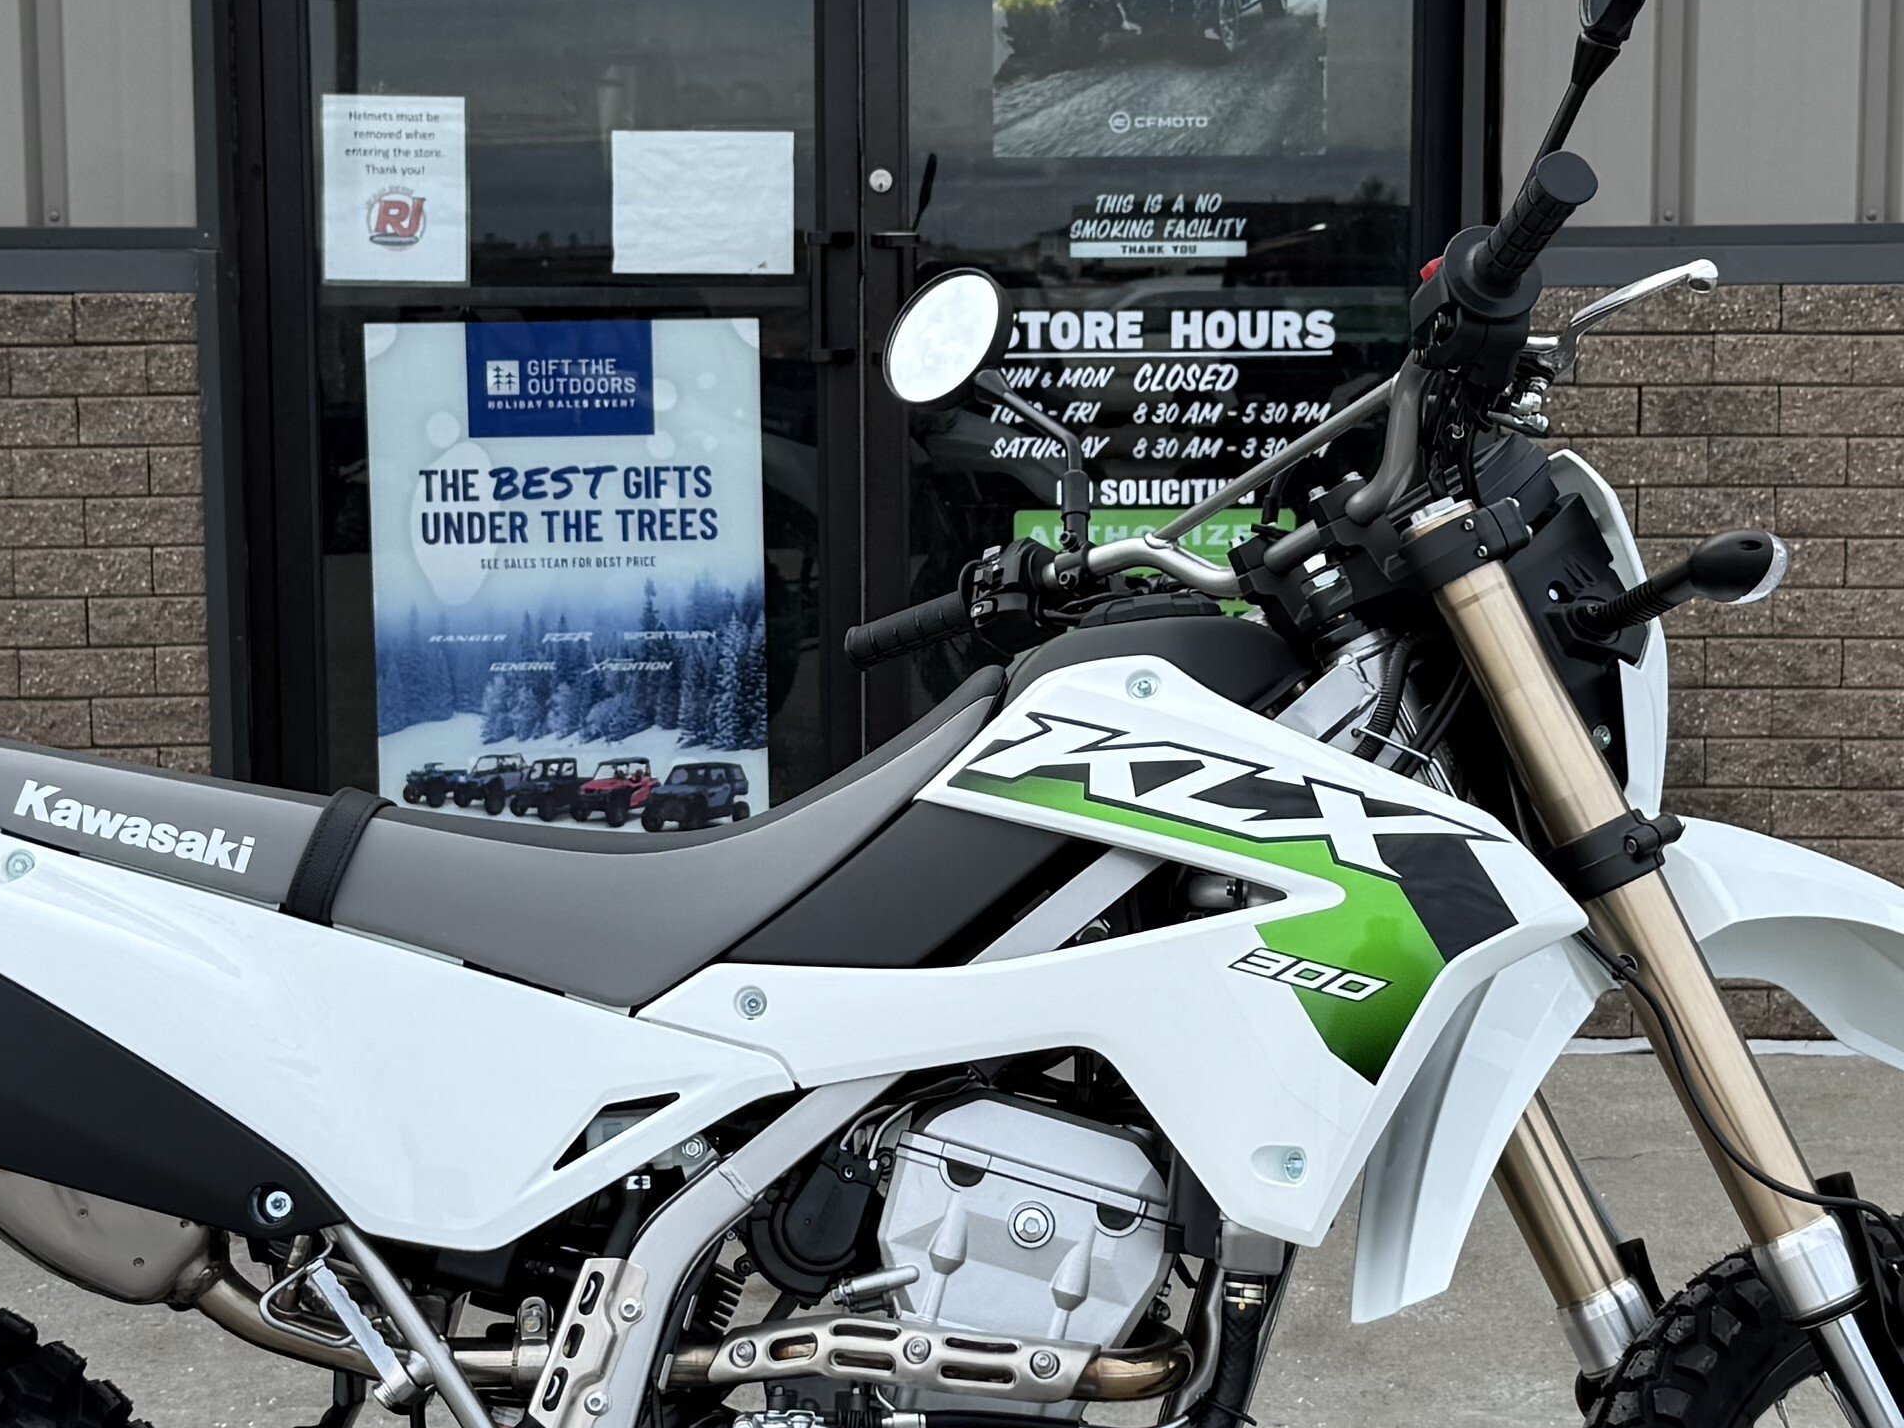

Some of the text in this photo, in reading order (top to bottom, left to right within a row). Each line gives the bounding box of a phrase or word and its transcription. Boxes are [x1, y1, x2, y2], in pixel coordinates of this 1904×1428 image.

[348, 111, 440, 122] Helmets must be
[1134, 116, 1208, 128] CFMOTO
[354, 129, 435, 140] removed when
[345, 147, 390, 160] entering
[393, 147, 411, 158] the
[365, 164, 397, 175] Thank
[1095, 193, 1223, 214] THIS IS A NO
[375, 197, 426, 237] RJ
[1069, 218, 1247, 240] SMOKING FACILITY
[1120, 244, 1197, 255] THANK YOU
[1170, 309, 1336, 350] HOURS
[527, 358, 617, 376] GIFT THE
[527, 377, 637, 395] OUTDOORS
[1000, 366, 1041, 389] UN
[1056, 365, 1116, 388] MON
[1133, 363, 1239, 393] CLOSED
[487, 398, 636, 410] HOLIDAY SALES EVENT
[1061, 401, 1102, 424] FRI
[1151, 402, 1180, 424] 30
[1180, 401, 1224, 424] AM
[1260, 402, 1288, 424] 30
[1291, 401, 1332, 424] PM
[990, 436, 1111, 460] SATURAY
[1151, 437, 1179, 459] 30
[1180, 436, 1224, 459] AM
[419, 465, 713, 503] THE BEST GIFTS
[421, 508, 719, 546] UNDER THE TREES
[480, 556, 657, 570] SEE SALES TEAM FOR BEST PRICE
[489, 662, 558, 672] GENERAL
[966, 712, 1512, 878] KLX
[13, 779, 256, 874] Kawasaki
[1227, 947, 1394, 1002] 300
